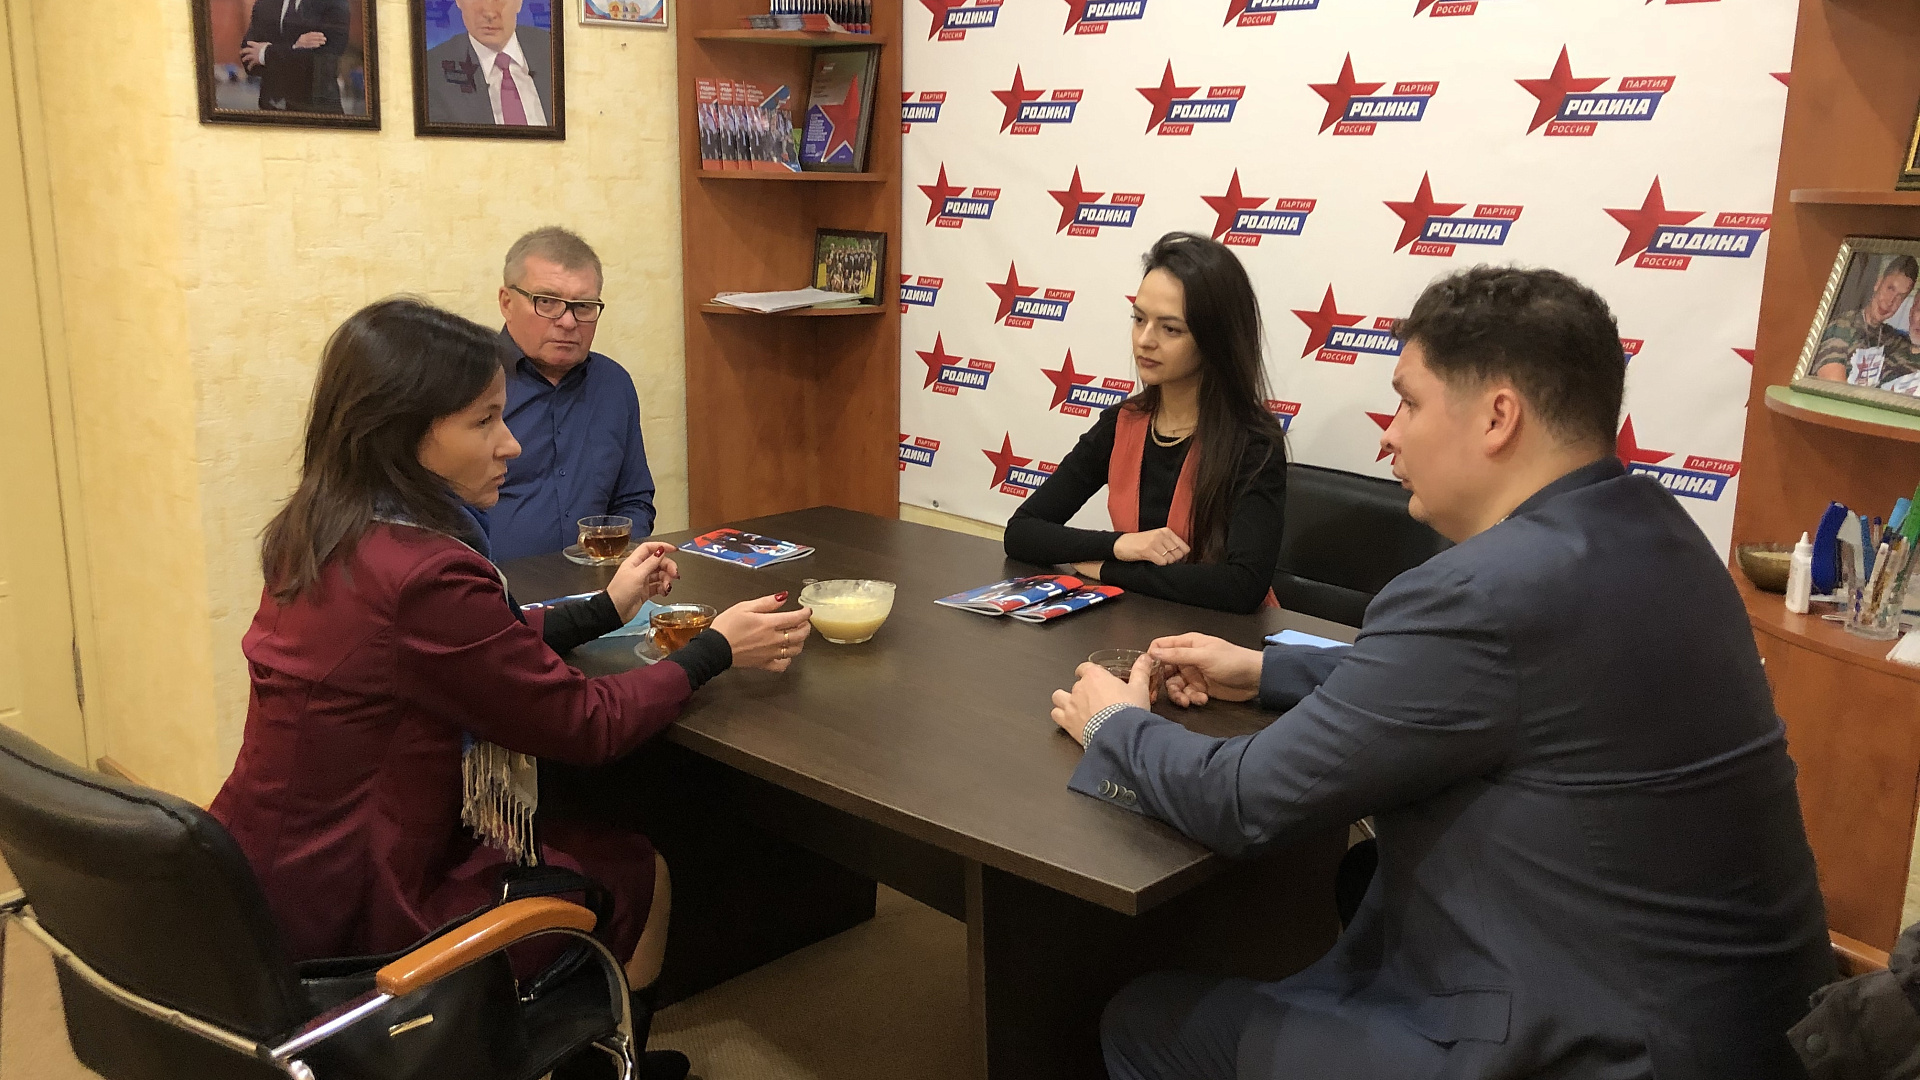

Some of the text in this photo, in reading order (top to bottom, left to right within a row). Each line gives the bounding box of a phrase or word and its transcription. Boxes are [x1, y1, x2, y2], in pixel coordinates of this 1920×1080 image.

[1086, 1, 1141, 18] РОДИНА
[1435, 4, 1472, 14] РОССИЯ
[948, 10, 994, 26] РОДИНА
[1241, 15, 1272, 24] РОССИЯ
[1078, 24, 1105, 33] РОССИЯ
[1398, 83, 1434, 94] ПАРТИЯ
[1625, 79, 1668, 89] ПАРТИЯ
[1055, 91, 1080, 100] ПАРТИЯ
[1212, 87, 1241, 97] ПАРТИЯ
[902, 106, 937, 119] ОДИНА
[1021, 105, 1071, 120] РОДИНА
[1170, 103, 1231, 119] РОДИНА
[1349, 101, 1421, 118] РОДИНА
[1564, 98, 1652, 116] РОДИНА
[1161, 125, 1190, 134] РОССИЯ
[1338, 124, 1372, 134] РОССИЯ
[1550, 124, 1591, 134] РОССИЯ
[1114, 194, 1141, 204] ПАРТИЯ
[945, 200, 989, 215] РОДИНА
[1280, 200, 1312, 210] ПАРТИЯ
[1078, 207, 1132, 223] РОДИНА
[1479, 206, 1517, 217] ПАРТИЯ
[1237, 214, 1300, 231] РОДИНА
[1721, 215, 1768, 225] ПАРТИЯ
[1070, 226, 1096, 235] РОССИЯ
[1426, 222, 1503, 241] РОДИНА
[1227, 234, 1257, 244] РОССИЯ
[1655, 232, 1750, 252] РОДИНА
[1414, 244, 1450, 255] РОССИЯ
[1641, 256, 1684, 268] РОССИЯ
[901, 288, 934, 302] ОДИНА
[1047, 290, 1072, 299] ПАРТИЯ
[1014, 300, 1064, 318] РОДИНА
[1331, 331, 1399, 351] РОДИНА
[1320, 352, 1353, 362] РОССИЯ
[941, 369, 985, 387] РОДИНА
[1105, 380, 1132, 389] ПАРТИЯ
[1063, 406, 1088, 415] РОССИЯ
[1041, 463, 1058, 471] ПАРТ
[1691, 459, 1735, 472] ПАРТИЯ
[1010, 470, 1048, 487] РОДИ
[1632, 468, 1717, 495] ДИНА
